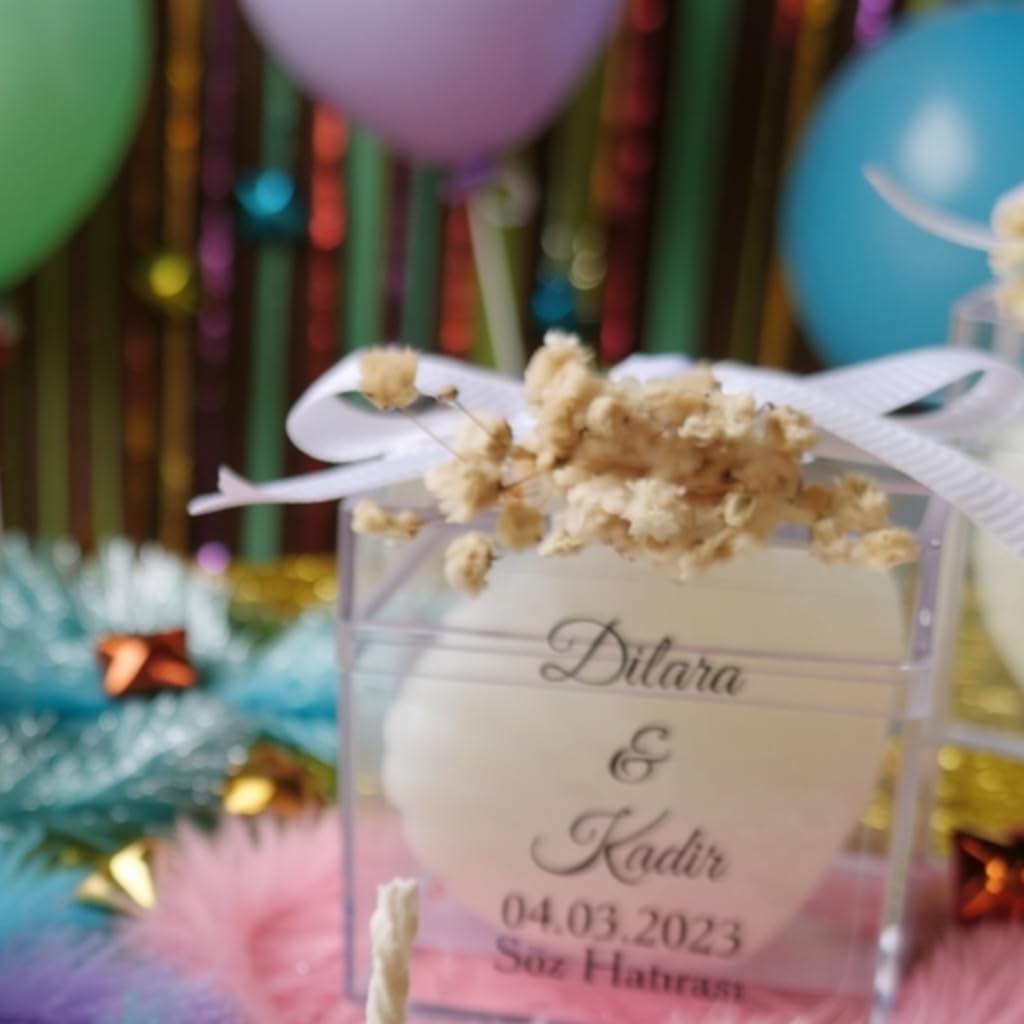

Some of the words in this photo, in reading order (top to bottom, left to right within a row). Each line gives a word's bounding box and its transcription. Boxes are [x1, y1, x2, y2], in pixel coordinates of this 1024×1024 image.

[539, 616, 746, 696] Dilara
[609, 722, 671, 783] &
[530, 807, 729, 886] Kadir
[501, 891, 743, 958] 04.03.2023
